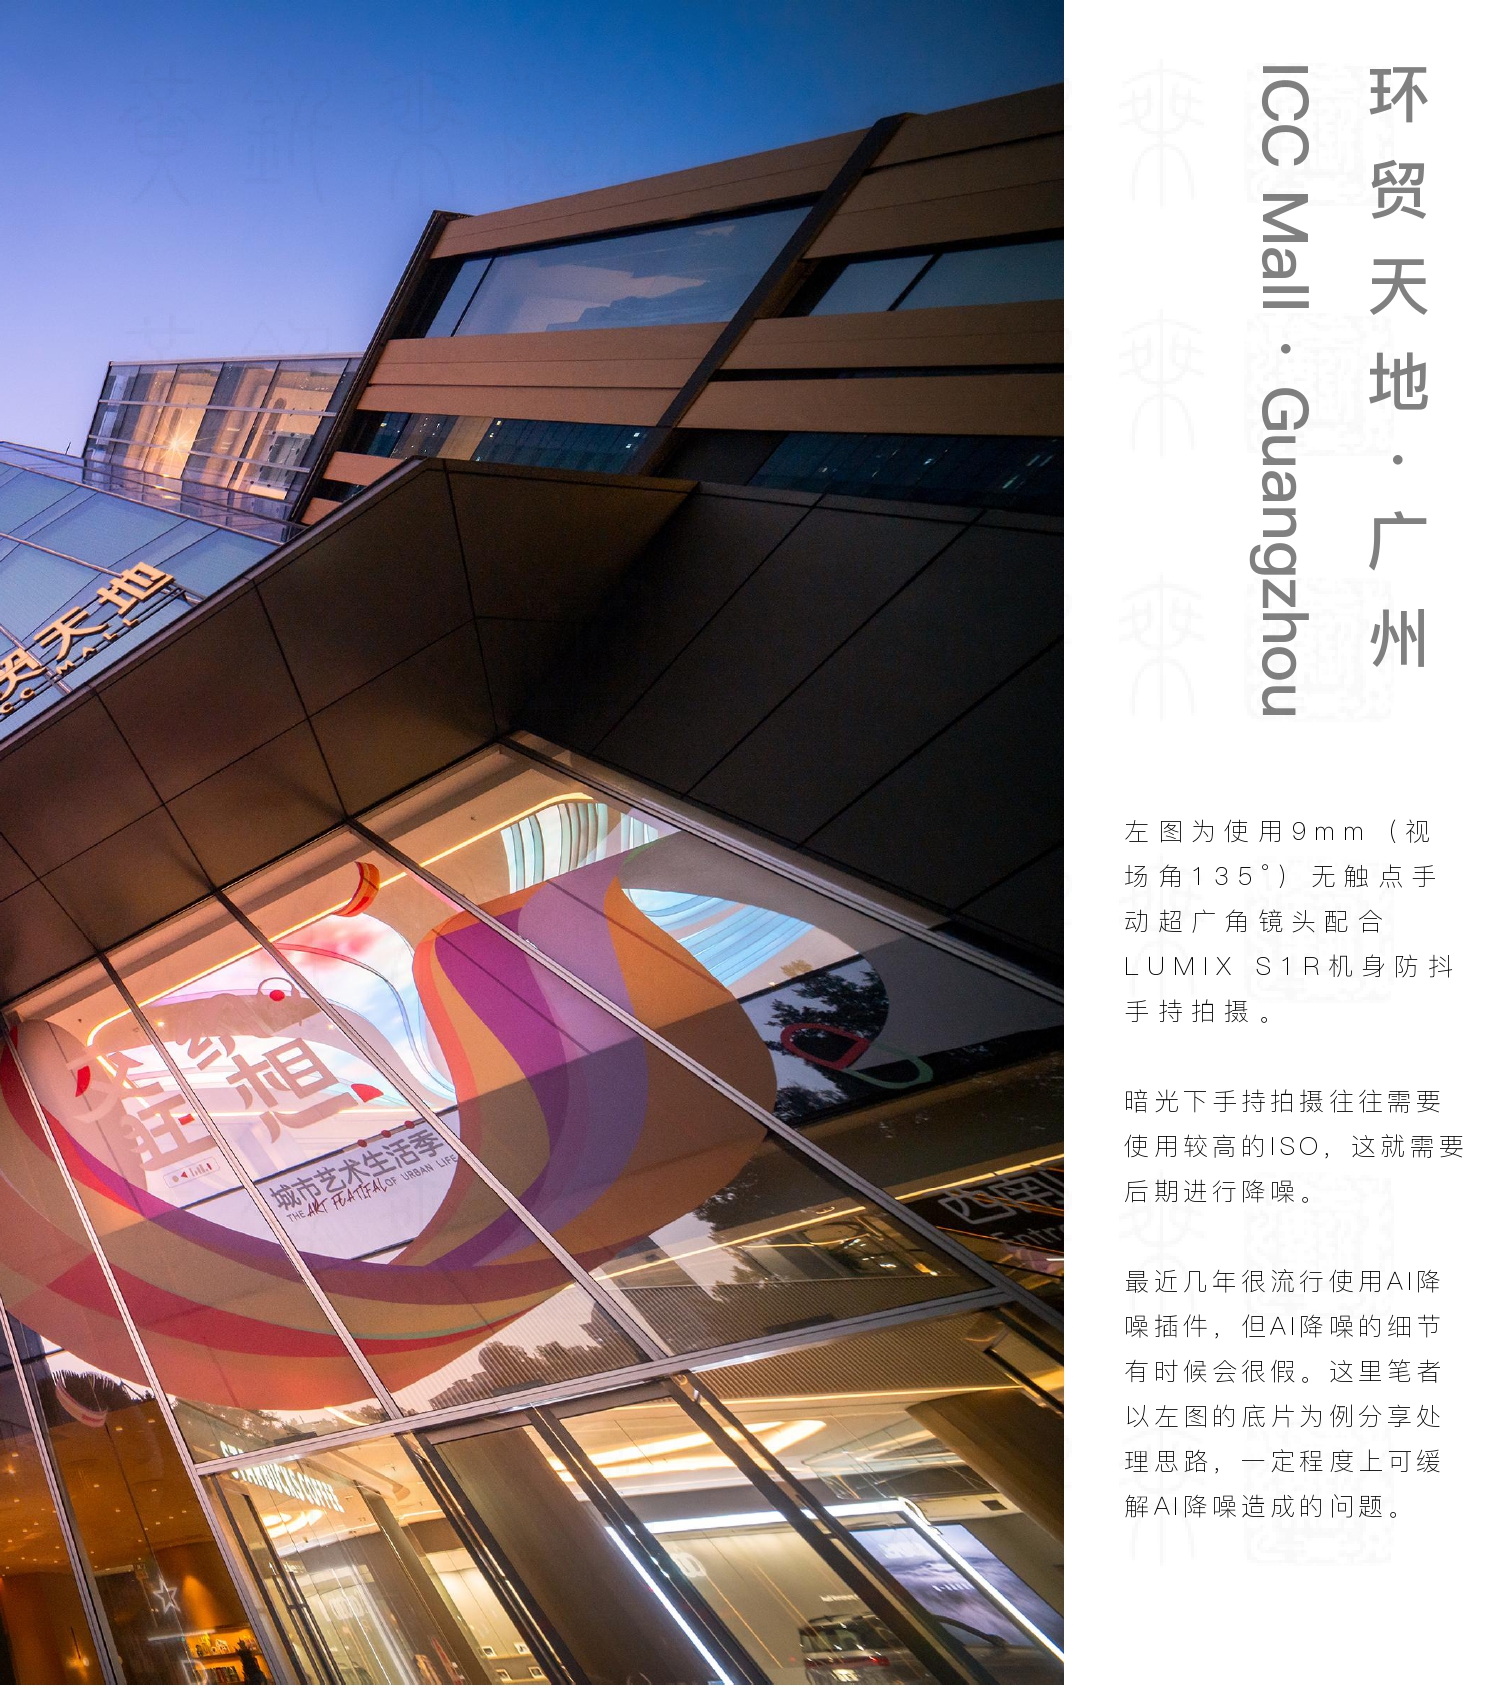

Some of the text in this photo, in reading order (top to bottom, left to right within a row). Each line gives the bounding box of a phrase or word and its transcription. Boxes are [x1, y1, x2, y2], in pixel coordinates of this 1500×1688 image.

[56, 617, 140, 676] MALL
[270, 1128, 444, 1211] 城市艺术生活季
[286, 1210, 307, 1223] THE
[307, 1197, 329, 1218] ART
[385, 1176, 398, 1187] OF
[400, 1163, 434, 1182] URBAN
[435, 1154, 459, 1169] LIFE
